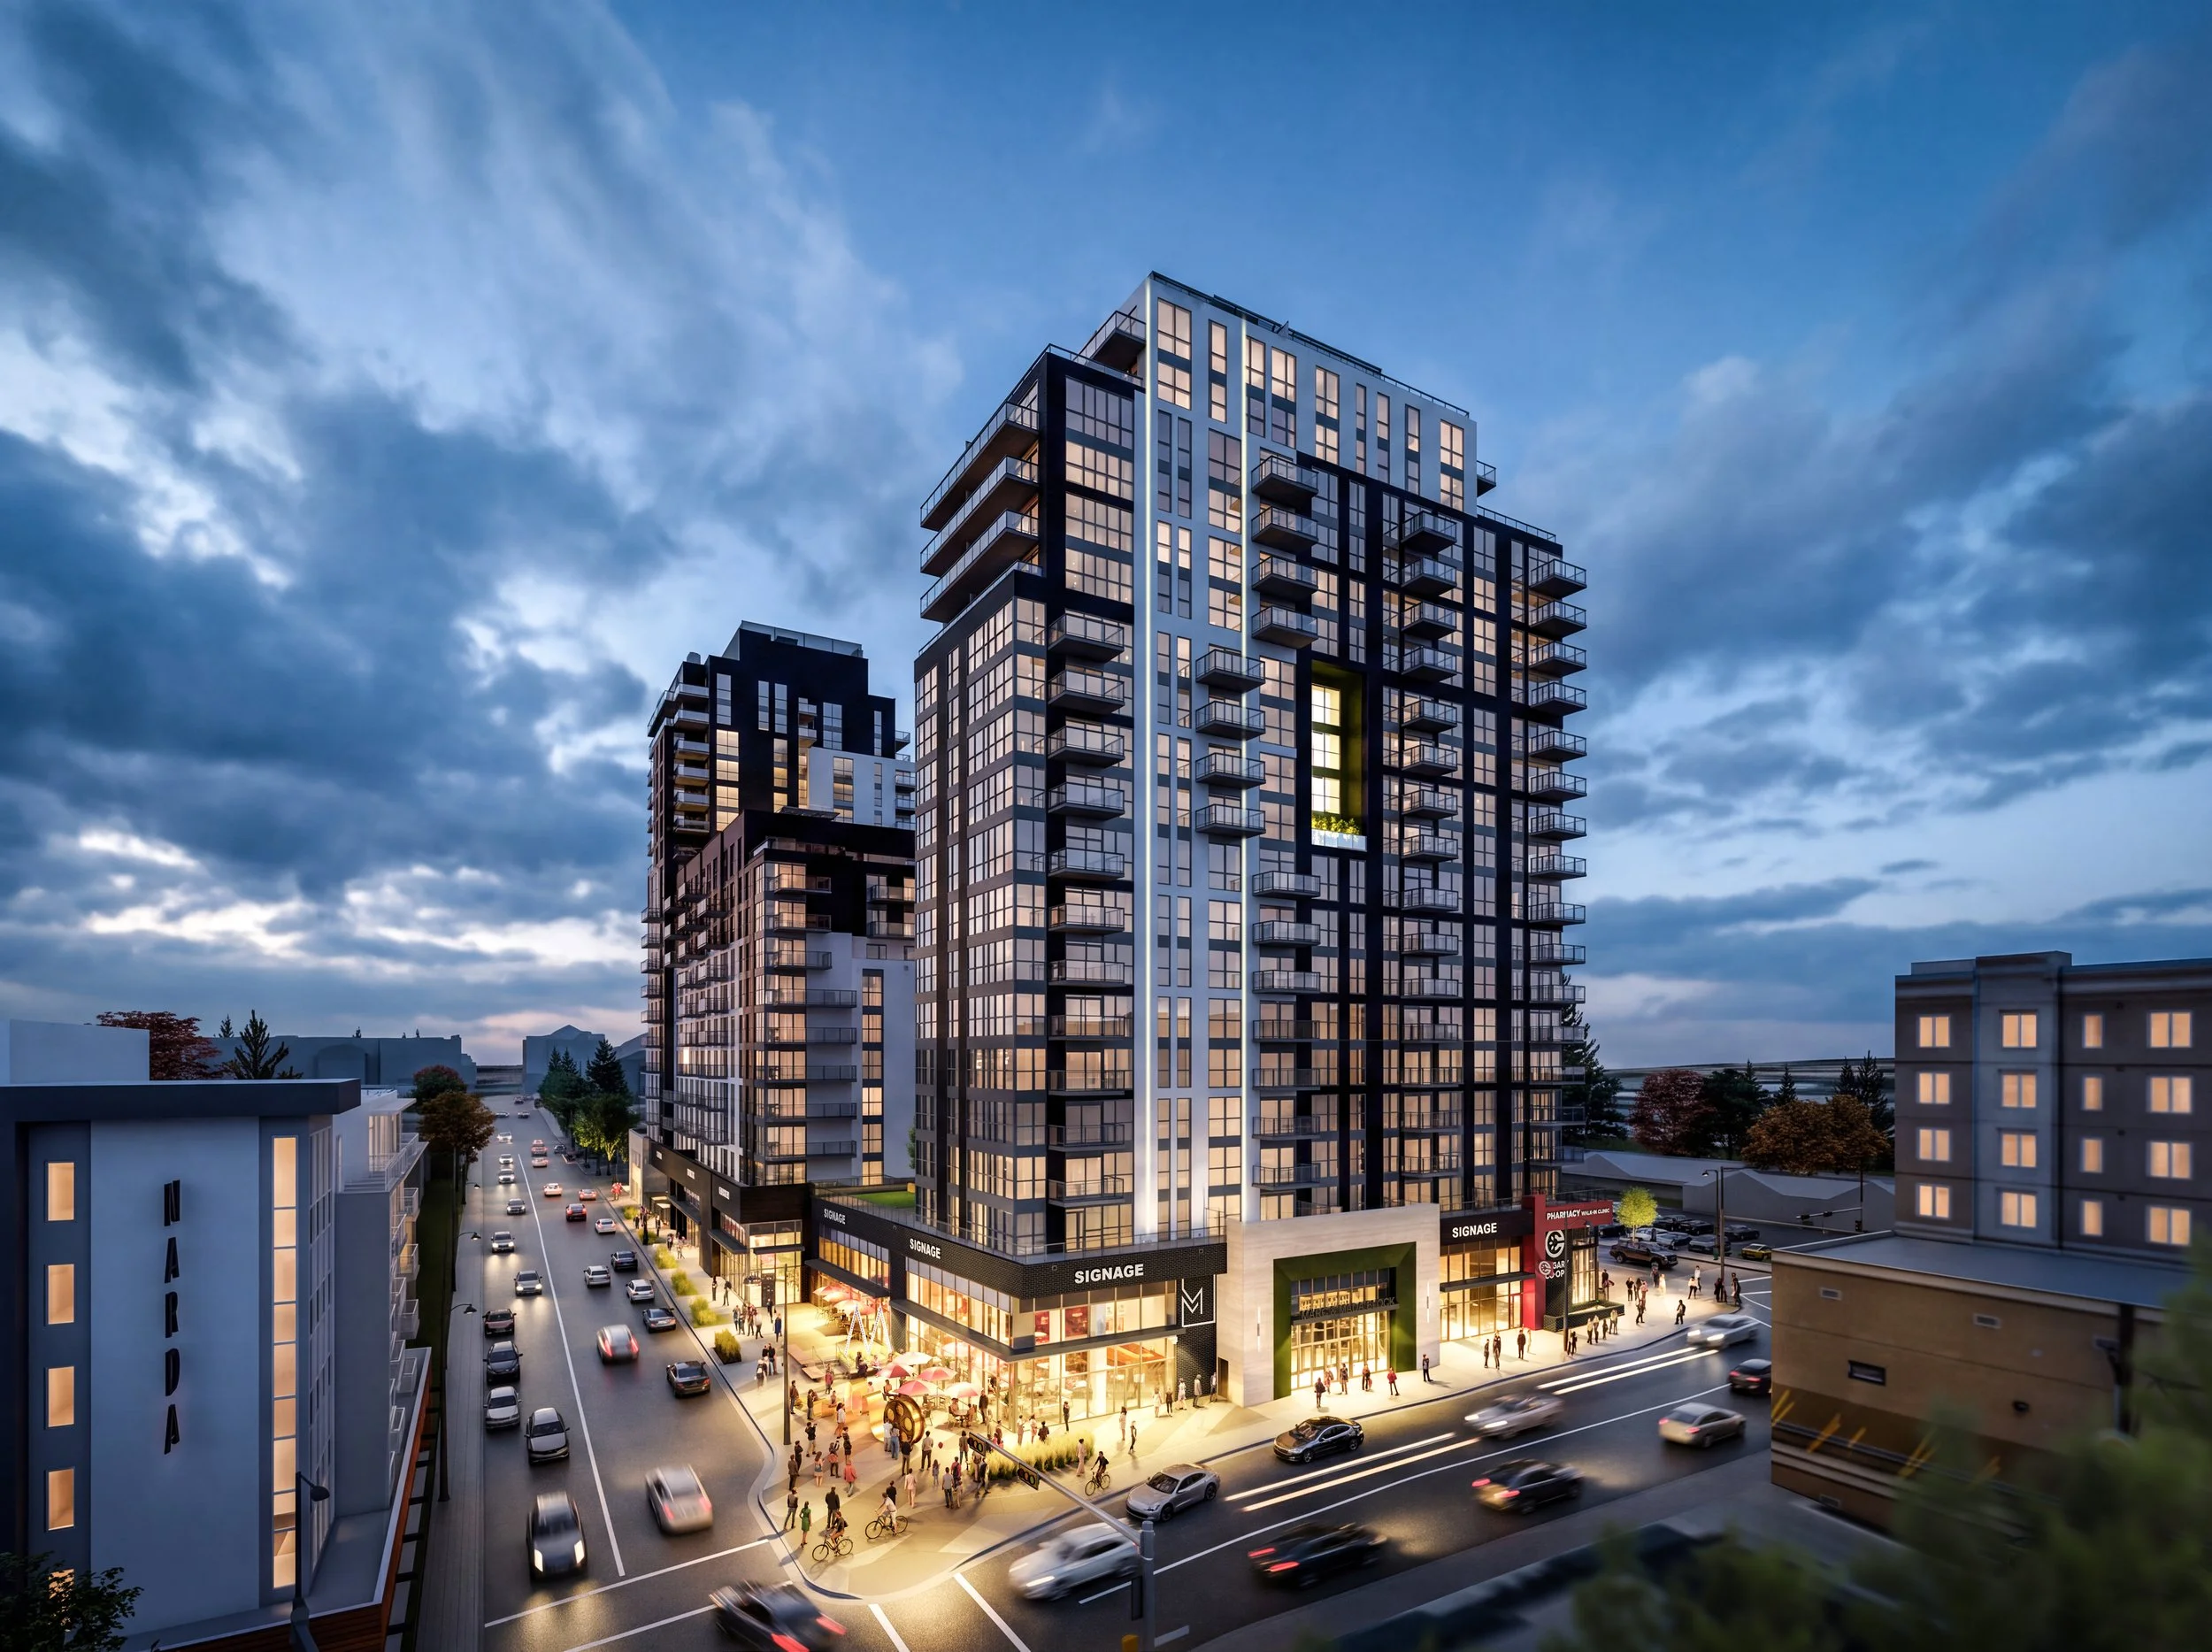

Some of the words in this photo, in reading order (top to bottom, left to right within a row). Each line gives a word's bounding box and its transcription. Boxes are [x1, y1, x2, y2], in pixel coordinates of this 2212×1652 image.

[823, 1208, 846, 1225] SIGNAGE
[1452, 1222, 1497, 1238] SIGNAGE
[910, 1239, 941, 1259] SIGNAGE
[1074, 1264, 1144, 1284] SIGNAGE
